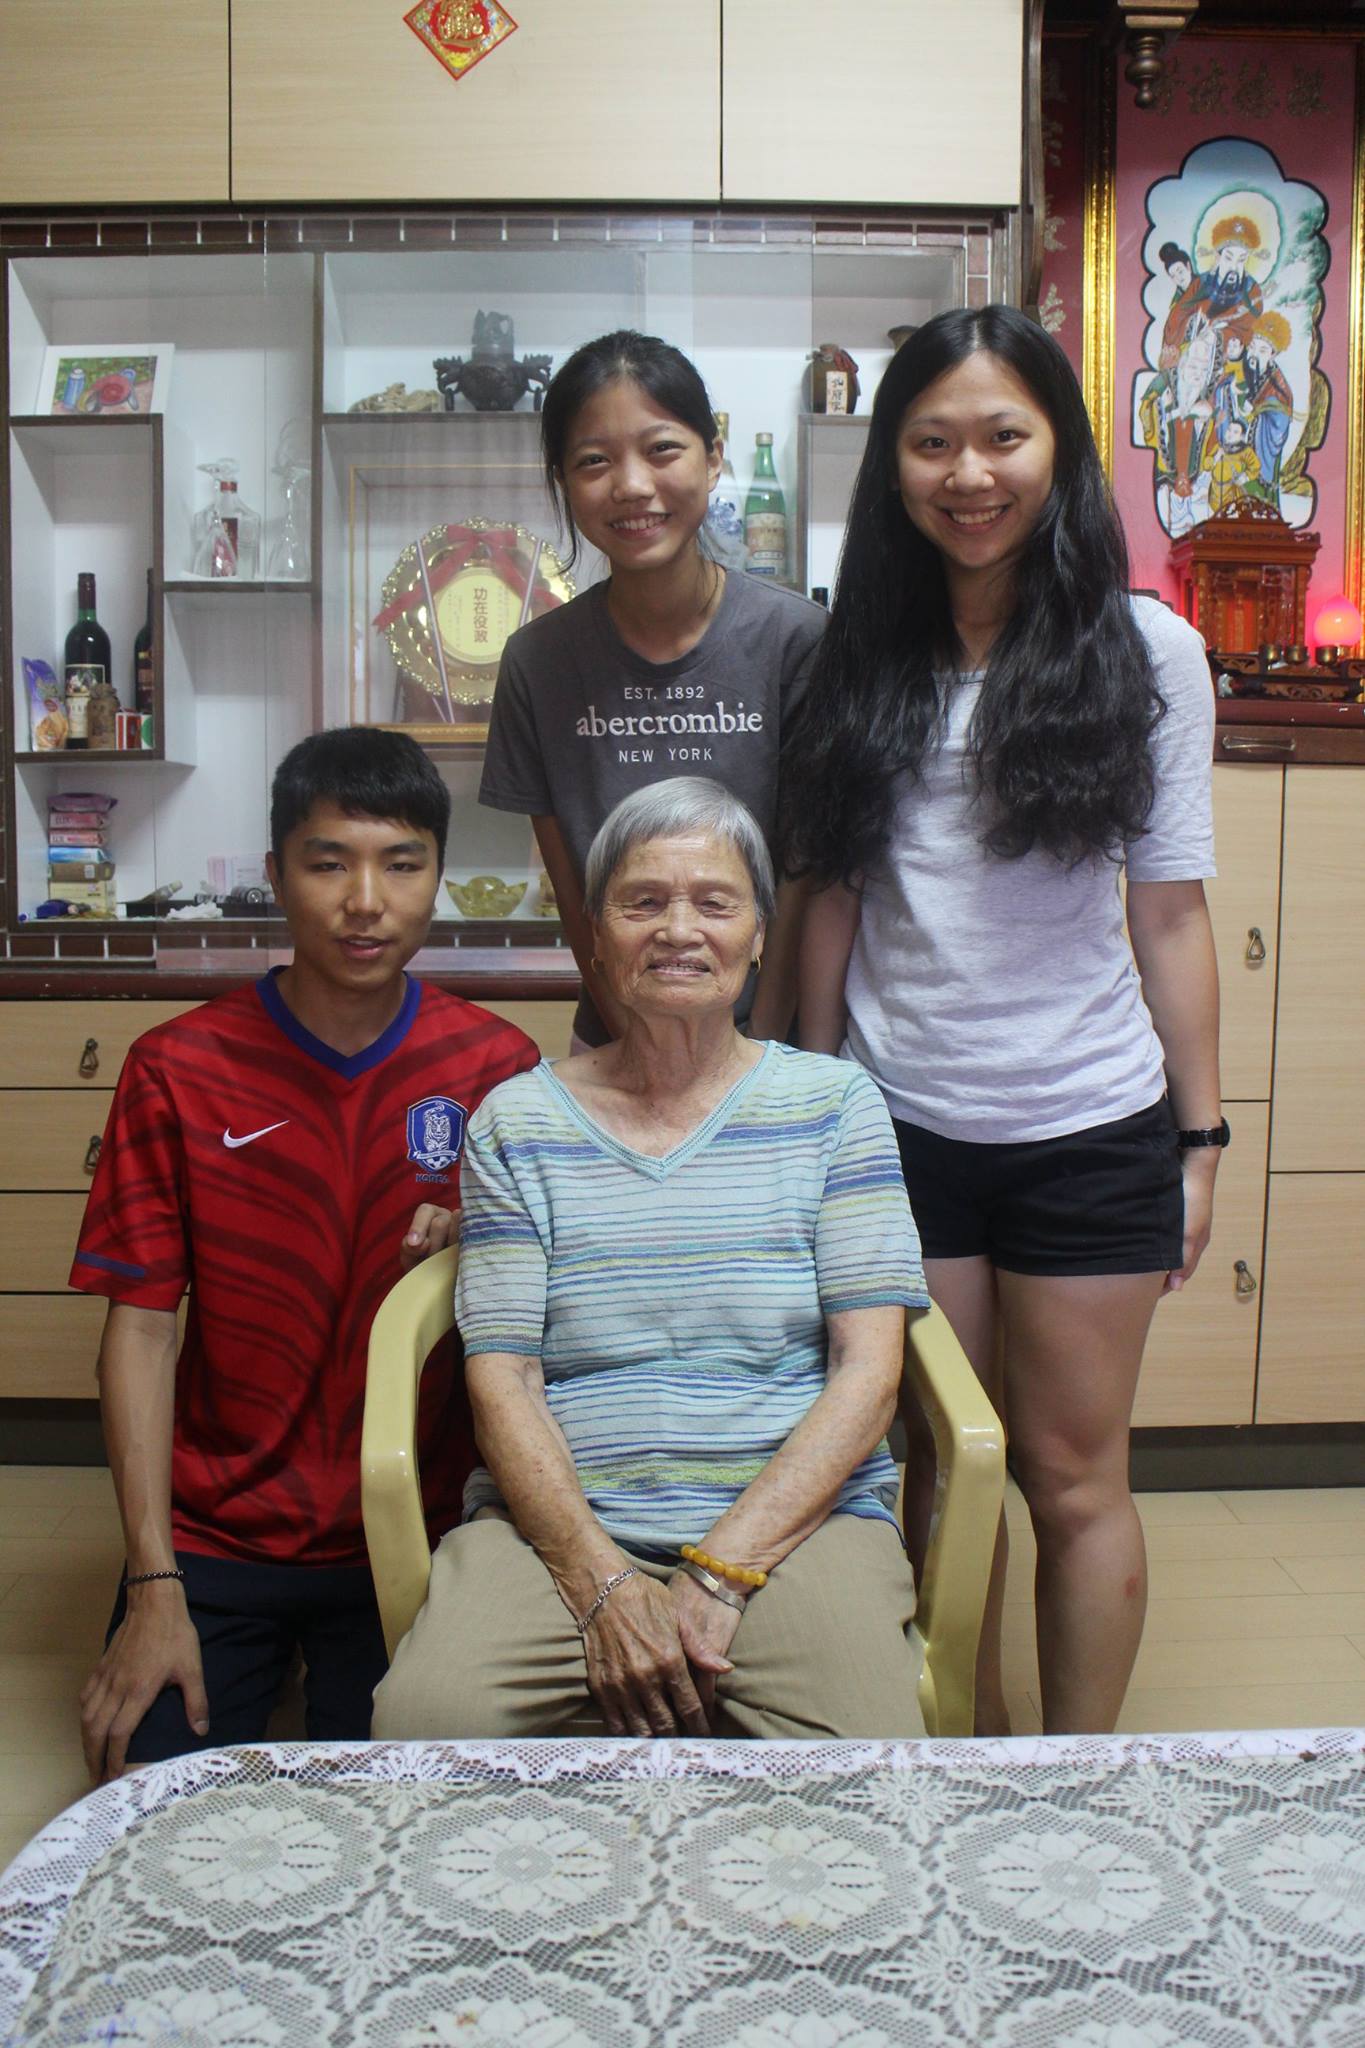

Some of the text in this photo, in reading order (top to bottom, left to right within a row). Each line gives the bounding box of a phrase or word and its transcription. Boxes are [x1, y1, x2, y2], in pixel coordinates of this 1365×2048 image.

[473, 587, 488, 643] 功在役政
[624, 686, 704, 700] EST. 1892
[576, 701, 763, 737] abercrombie
[618, 748, 713, 763] NEW YORK
